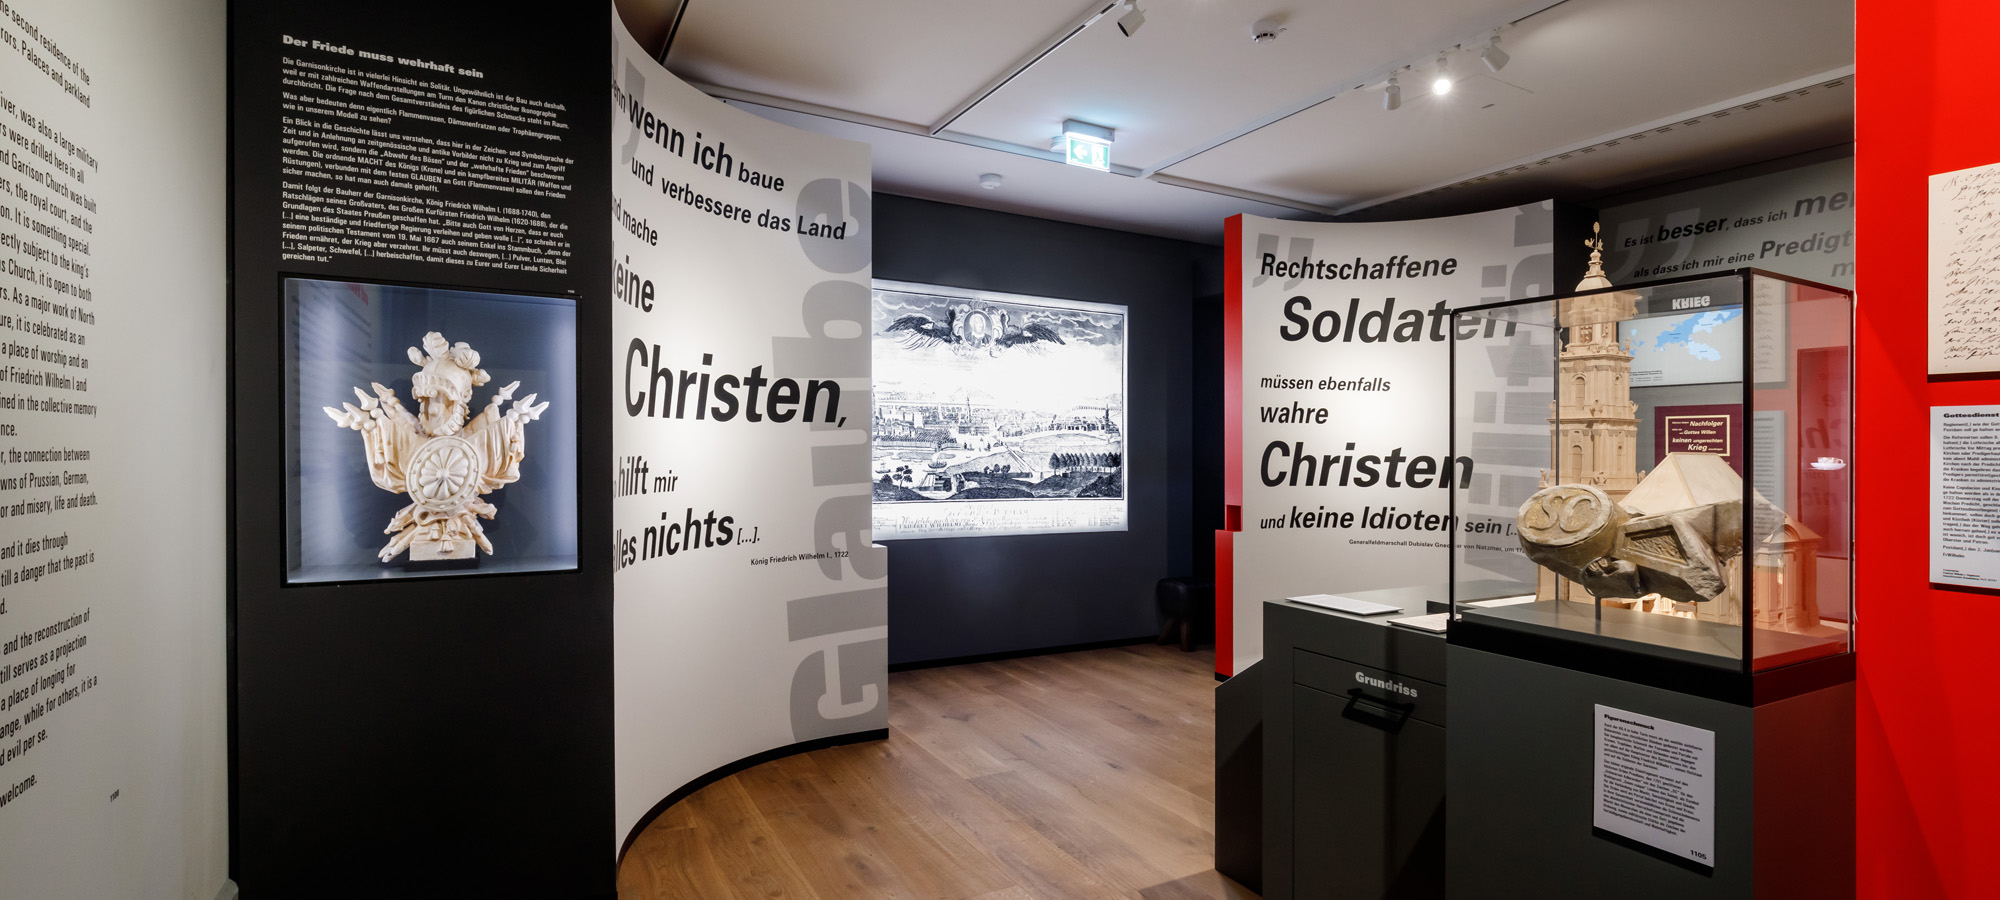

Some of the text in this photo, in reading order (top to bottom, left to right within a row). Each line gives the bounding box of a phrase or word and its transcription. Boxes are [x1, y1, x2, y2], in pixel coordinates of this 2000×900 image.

[12, 10, 90, 86] second residence of the
[283, 35, 483, 78] Der Friede muss wehrhaft sein
[22, 40, 90, 108] Palaces and parkland
[283, 57, 294, 65] Die
[296, 60, 345, 74] Garnisonkirche
[358, 69, 364, 77] in
[366, 71, 390, 81] vielerlei
[392, 75, 417, 86] Hinsicht
[430, 82, 451, 92] Solitär.
[454, 86, 494, 99] Ungewöhnlich
[505, 94, 514, 102] der
[516, 96, 527, 104] Bau
[544, 101, 566, 111] deshalb,
[283, 92, 297, 100] Was
[317, 97, 347, 108] bedeuten
[349, 102, 364, 111] denn
[367, 106, 397, 116] eigentlich
[398, 110, 446, 124] Flammenvasen,
[448, 118, 496, 131] Dämonenfratzen
[512, 127, 561, 141] Trophäengruppen,
[306, 106, 334, 116] unserem
[336, 110, 358, 120] Modell
[370, 116, 391, 124] sehen?
[628, 93, 684, 158] wenn
[693, 132, 732, 178] ich
[738, 162, 784, 192] baue
[12, 152, 44, 184] Garrison
[46, 172, 68, 198] Church
[70, 190, 82, 206] was
[283, 181, 303, 190] Damit
[305, 184, 321, 193] folgt
[323, 186, 334, 194] der
[336, 188, 362, 197] Bauherr
[376, 193, 424, 205] Garnisonkirche,
[426, 199, 443, 208] König
[445, 201, 471, 210] Friedrich
[473, 204, 495, 212] Wilhelm
[631, 156, 846, 240] und verbessere das Land
[623, 208, 658, 246] mache
[1624, 238, 1637, 248] Es
[1640, 234, 1654, 245] ist
[1657, 216, 1730, 242] besser,
[1734, 214, 1764, 228] dass
[1768, 210, 1788, 222] ich
[1261, 252, 1458, 280] Rechtschaffene
[1634, 268, 1650, 278] als
[1652, 264, 1678, 276] dass
[1682, 260, 1699, 272] ich
[1703, 256, 1724, 268] mir
[1728, 252, 1754, 264] eine
[1280, 296, 1520, 344] Soldaten
[10, 366, 43, 386] Friedrich
[45, 372, 71, 390] Wilhelm
[76, 378, 87, 392] and
[626, 337, 848, 428] Christen,
[1260, 375, 1391, 392] müssen ebenfalls
[18, 394, 97, 418] in the collective memory
[1260, 401, 1329, 425] wahre
[9, 446, 90, 463] the connection between
[1688, 444, 1708, 452] Krieg
[20, 470, 89, 490] of Prussian, German,
[618, 456, 649, 498] hilft
[654, 470, 678, 493] mir
[1260, 440, 1474, 490] Christen
[10, 492, 98, 517] and misery, life and death.
[1260, 515, 1284, 530] und
[1290, 506, 1354, 530] keine
[1362, 506, 1458, 532] Idioten
[1464, 519, 1502, 534] sein
[0, 531, 68, 560] and it dies through
[642, 508, 734, 561] nichts
[1476, 544, 1502, 552] Natzmer,
[751, 558, 768, 566] König
[770, 554, 798, 564] Friedrich
[798, 552, 826, 560] Wilhelm
[834, 550, 849, 558] 1722
[4, 607, 90, 656] and the reconstruction of
[1356, 672, 1418, 698] Grundriss
[1604, 714, 1654, 730] Figurenschmuck
[8, 729, 48, 762] evil per se.
[0, 774, 38, 808] welcome.
[1690, 850, 1706, 860] 1105
